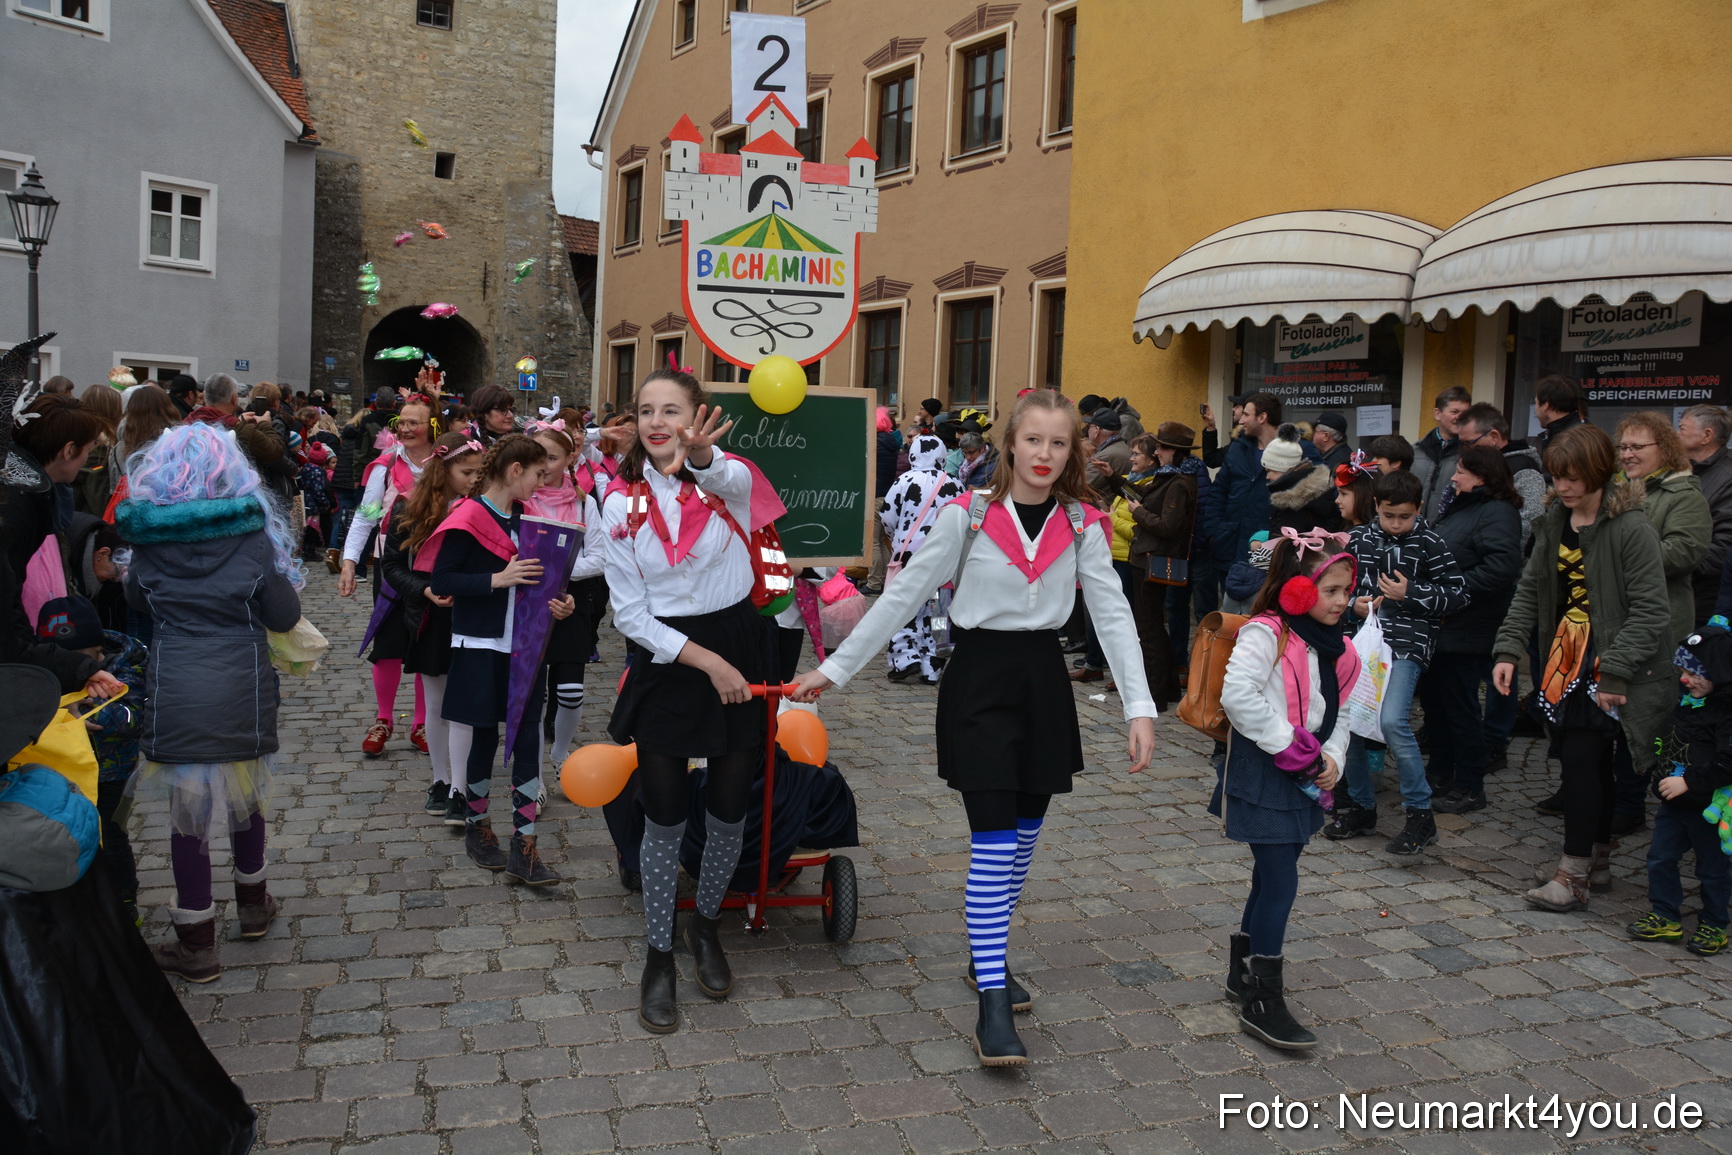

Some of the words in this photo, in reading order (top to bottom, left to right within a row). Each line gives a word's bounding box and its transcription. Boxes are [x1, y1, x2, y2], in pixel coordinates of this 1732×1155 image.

[753, 35, 791, 92] 2
[697, 249, 846, 286] BACHAMINIS
[1571, 303, 1673, 325] Fotoladen
[1282, 324, 1350, 341] Fotoladen
[1582, 315, 1693, 349] Christine
[1290, 333, 1364, 360] Christine
[1575, 354, 1620, 363] Mittwoch
[1623, 351, 1684, 362] Nachmittag
[1301, 385, 1317, 394] AM
[1319, 383, 1384, 393] BILDSCHIRM
[1599, 375, 1684, 388] FARBBILDER
[1688, 375, 1720, 386] VON
[1285, 396, 1347, 406] AUSSUCHEN
[1588, 389, 1712, 400] SPEICHERMEDIEN
